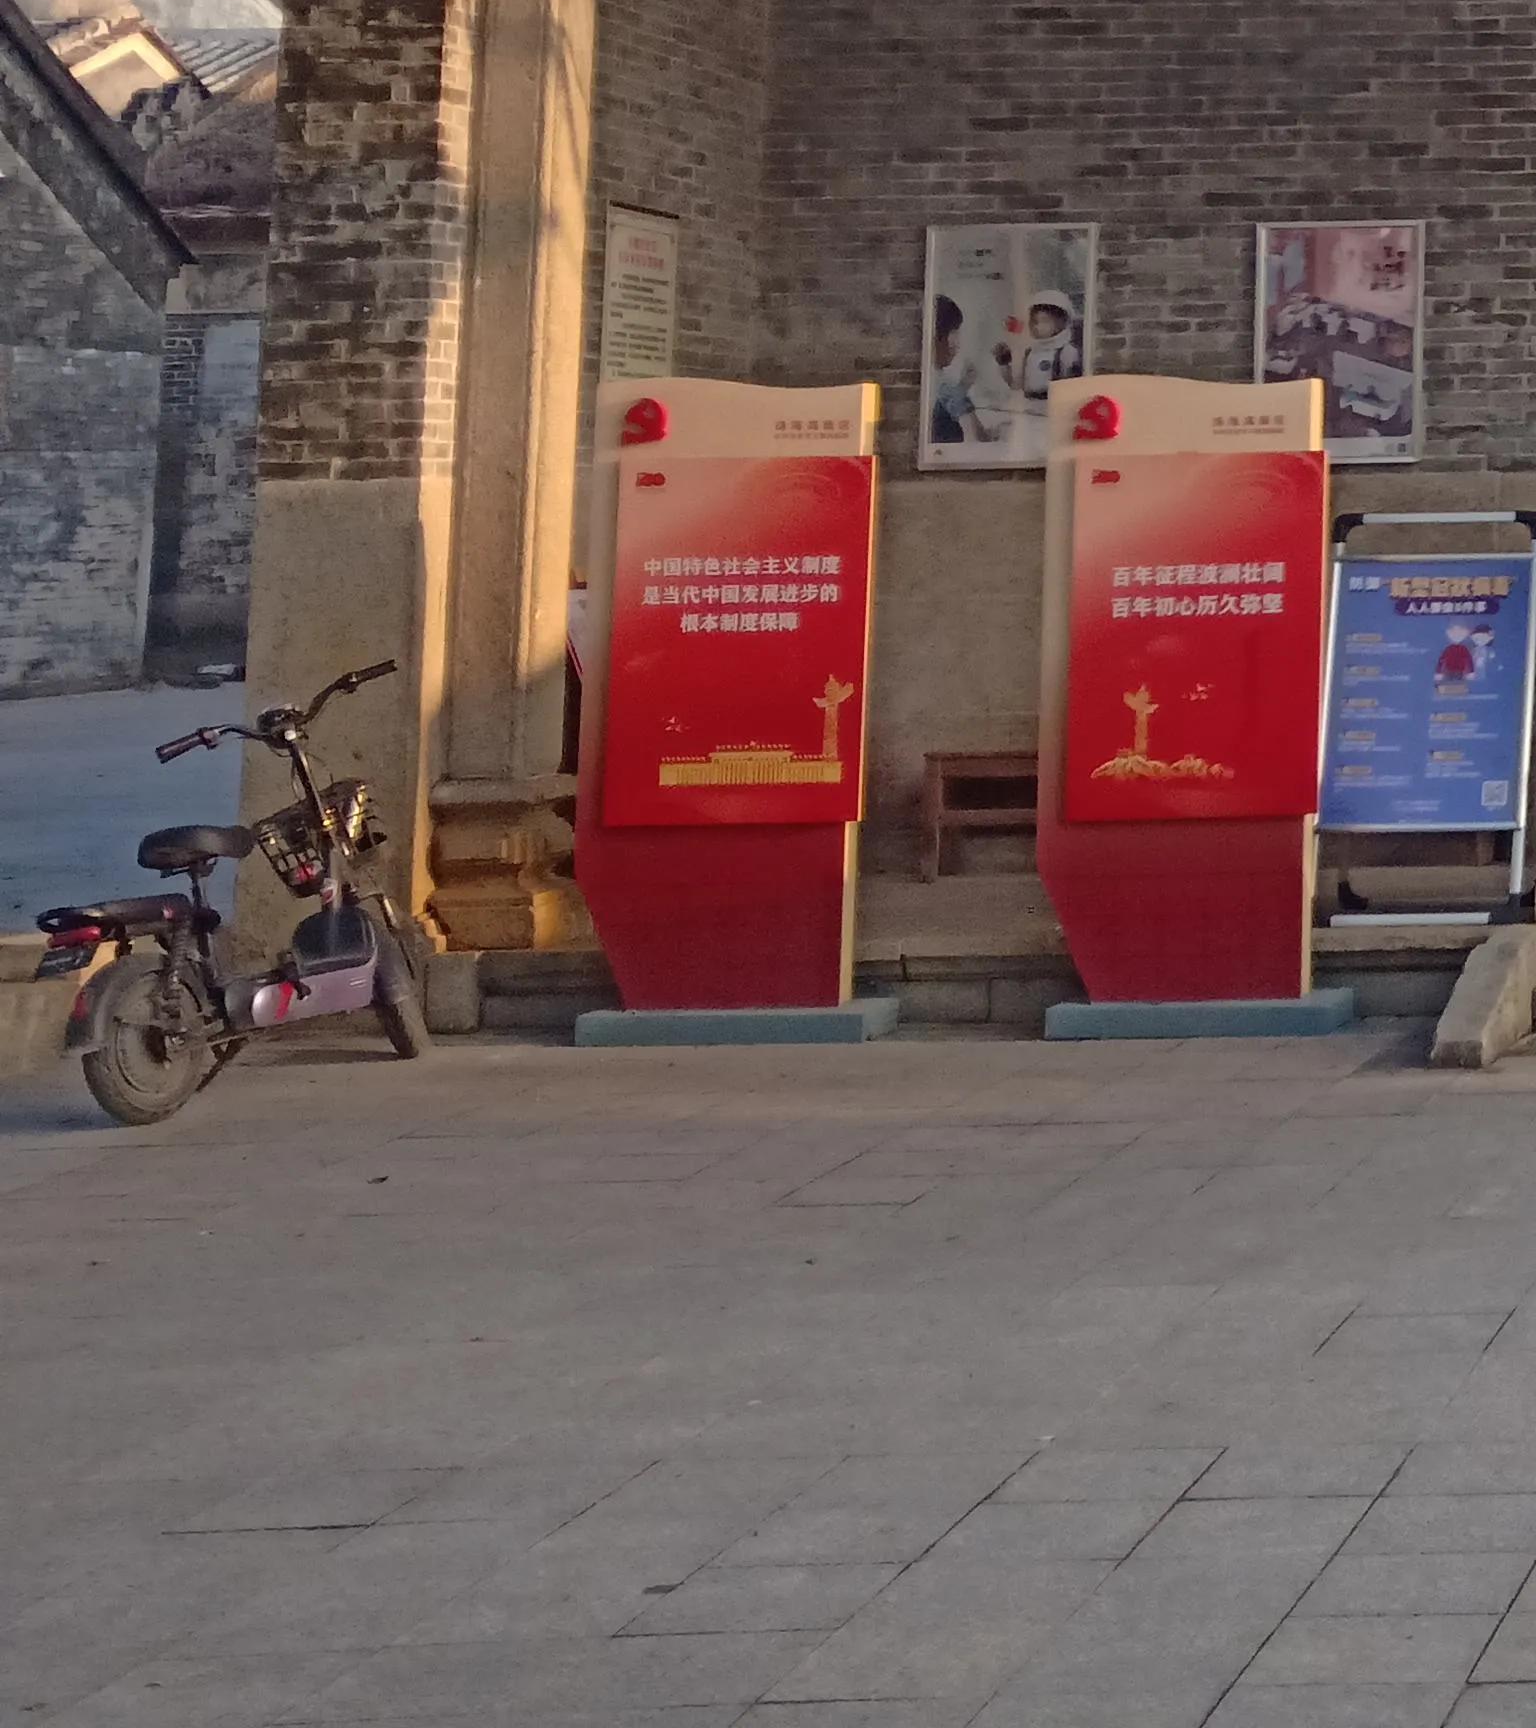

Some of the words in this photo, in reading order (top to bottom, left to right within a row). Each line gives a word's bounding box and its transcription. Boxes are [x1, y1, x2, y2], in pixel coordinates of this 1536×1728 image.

[642, 554, 841, 579] 中国特色社会主义制度
[1111, 561, 1287, 588] 百年征程波澜壮阔
[641, 582, 839, 606] 是当代中国发展进步的
[1110, 592, 1285, 619] 百年初心历久弥坚
[679, 611, 800, 634] 根本制度保障
